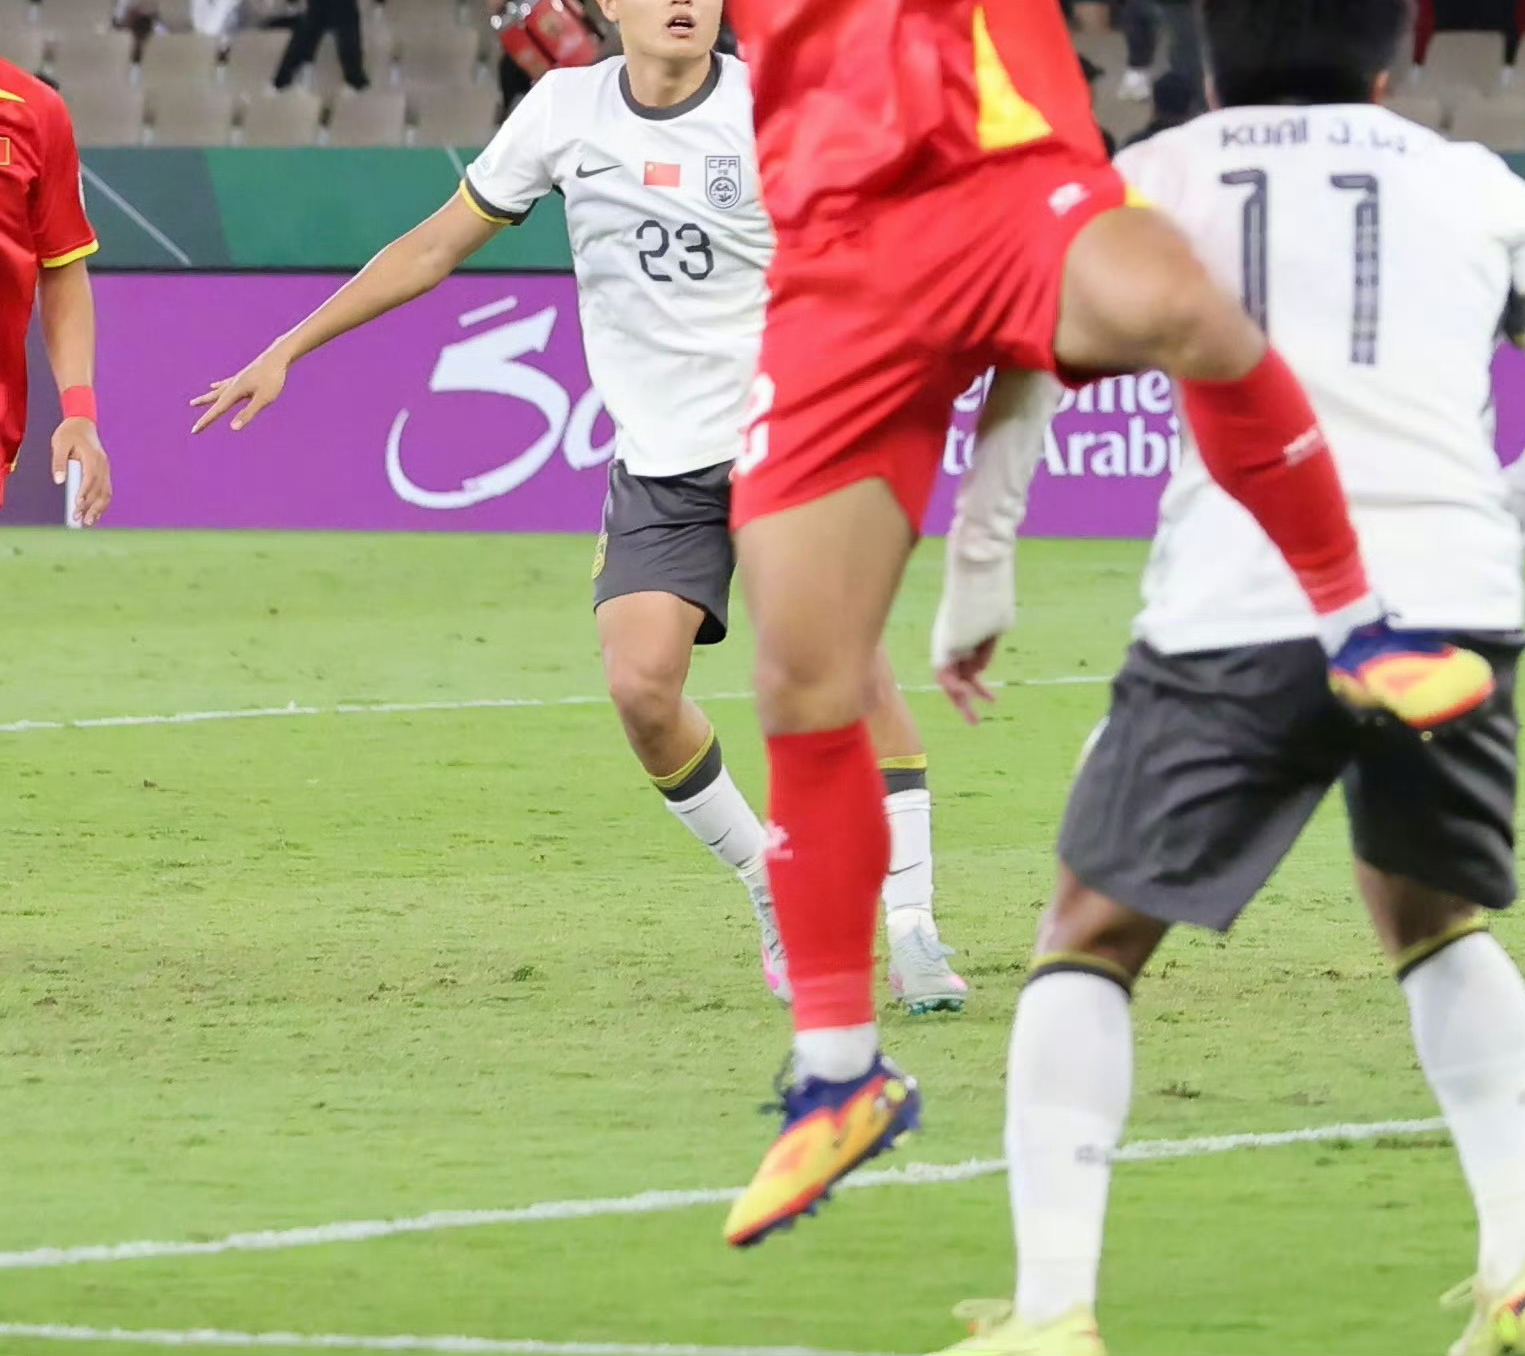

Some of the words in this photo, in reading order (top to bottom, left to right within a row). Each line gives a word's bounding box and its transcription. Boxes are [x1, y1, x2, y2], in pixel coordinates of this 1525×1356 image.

[708, 158, 739, 170] CFA
[635, 219, 716, 283] 23
[1217, 168, 1379, 366] 11
